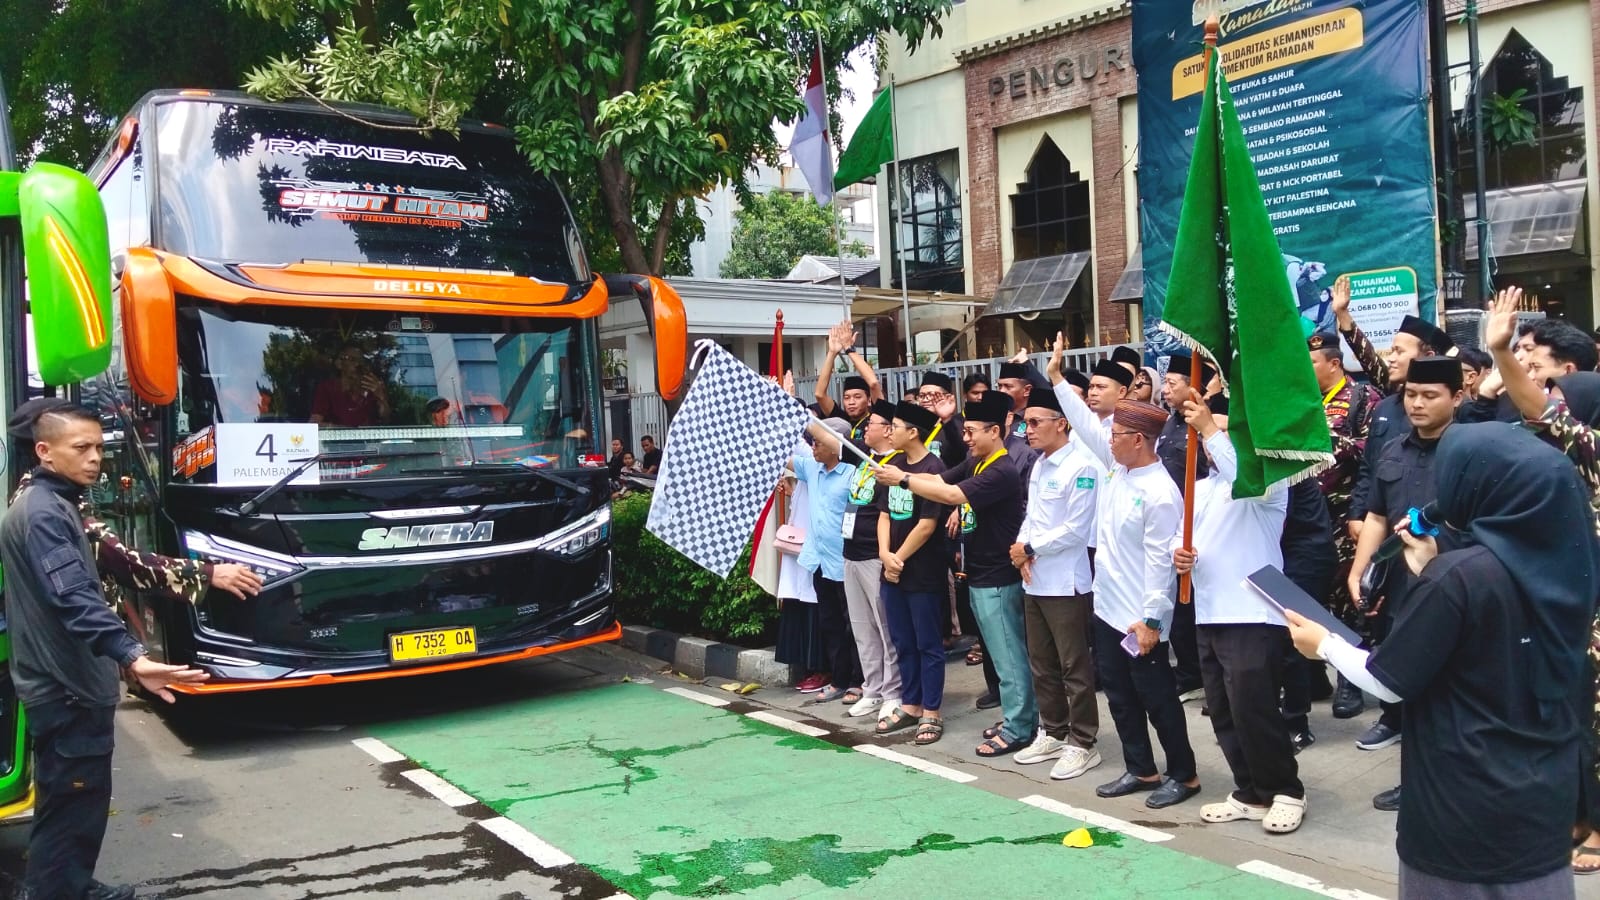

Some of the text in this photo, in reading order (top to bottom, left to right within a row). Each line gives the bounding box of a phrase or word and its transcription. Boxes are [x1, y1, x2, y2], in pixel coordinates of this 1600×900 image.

[1219, 0, 1303, 38] Ramadan
[1273, 18, 1346, 47] KEMANUSIAAN
[1183, 40, 1315, 78] SATUK OMENTUM RAMADAN
[988, 46, 1126, 107] PENGUR
[1241, 79, 1261, 91] BUKA
[1262, 77, 1267, 85] &
[1268, 69, 1295, 83] SAHUR
[1249, 91, 1271, 103] YATIM
[1272, 89, 1278, 97] &
[1279, 82, 1305, 96] DUAFA
[1251, 109, 1257, 117] &
[1258, 101, 1292, 116] WILAYAH
[1293, 89, 1343, 108] TERTINGGAL
[1248, 118, 1285, 134] SEMBAKO
[1285, 109, 1326, 125] RAMADAN
[1269, 136, 1275, 144] &
[1276, 124, 1328, 142] PSIKOSOSIAL
[267, 138, 467, 171] PARIWISATA
[1257, 149, 1285, 163] IBADAH
[1292, 139, 1330, 155] SEKOLAH
[1258, 154, 1339, 177] MADRASAH DARURAT
[1259, 169, 1344, 192] RAT & MCK PORTABEL
[279, 190, 488, 220] SEMUT HITAM
[1273, 195, 1285, 205] KIT
[1286, 187, 1330, 203] PALESTINA
[1268, 199, 1357, 221] TERDAMPAK BENCANA
[1273, 224, 1300, 235] GRATIS
[373, 280, 462, 295] DELISYA
[1349, 284, 1402, 297] ZAKAT ANDA
[1352, 276, 1397, 288] TUNAIKAN
[1357, 303, 1377, 312] 0680
[255, 433, 279, 463] 4
[233, 467, 296, 477] PALEMBAN
[358, 520, 495, 551] SAKERA
[395, 637, 404, 652] H
[414, 633, 446, 650] 7352
